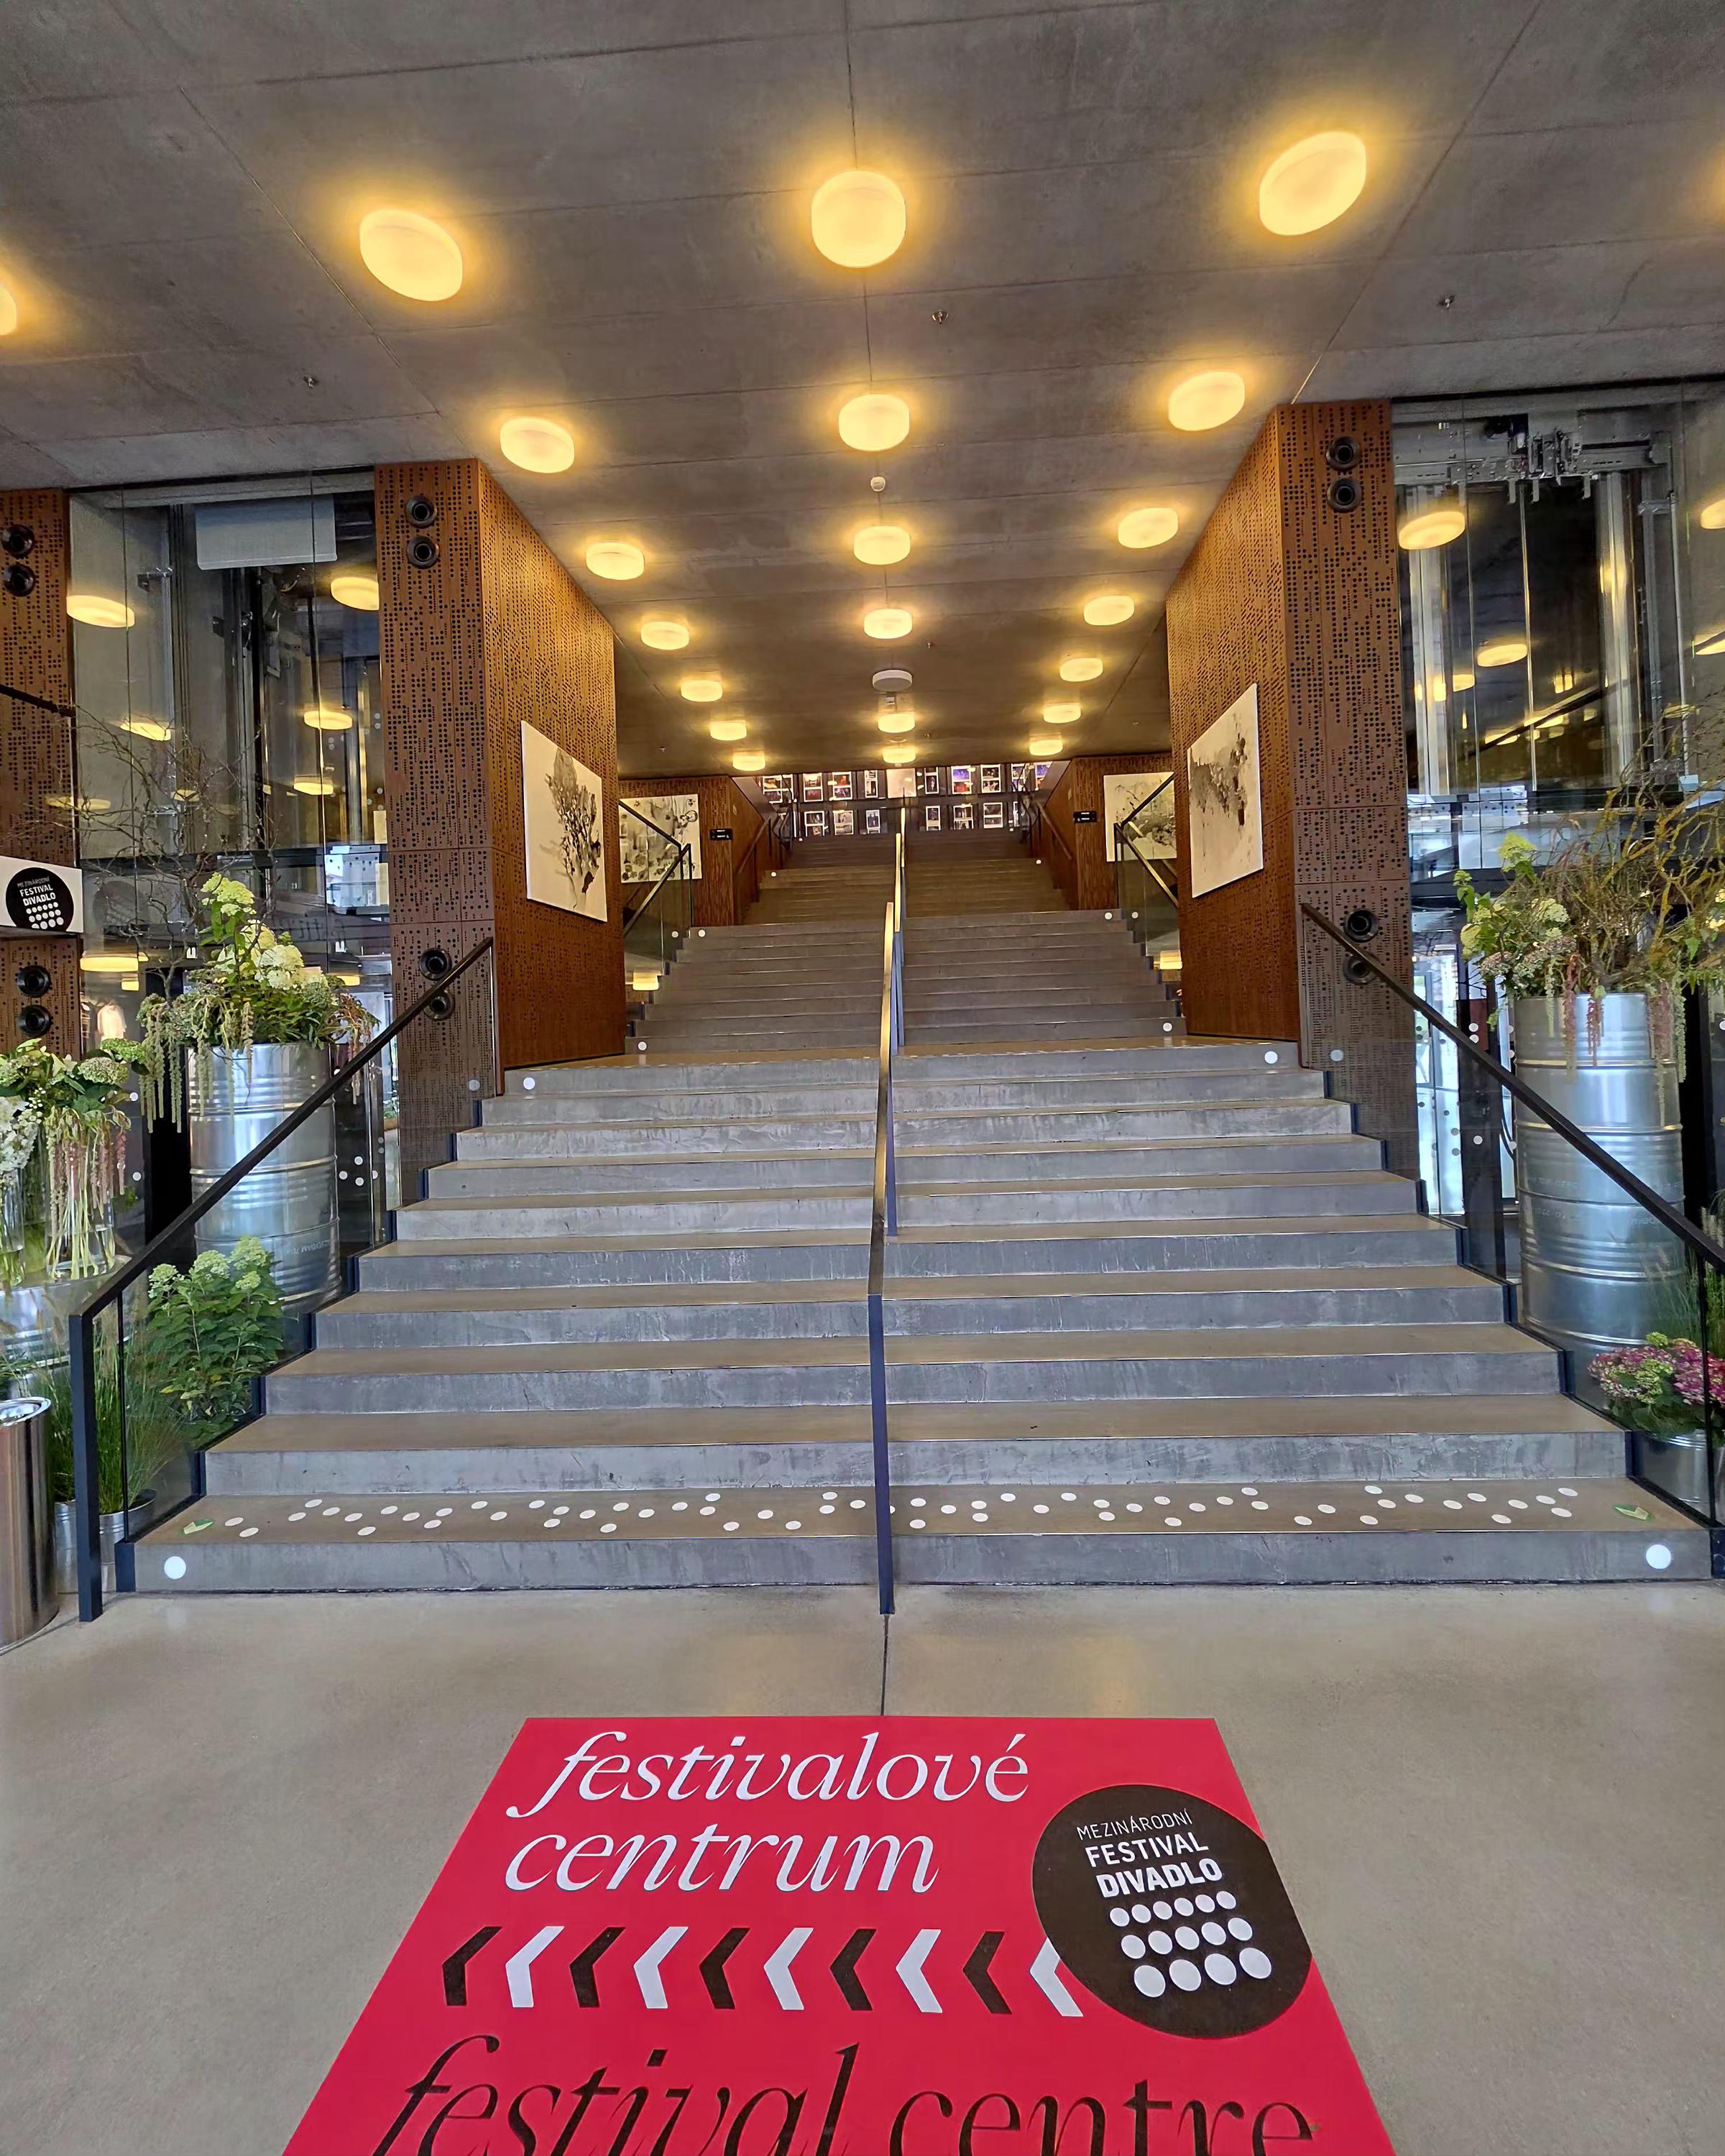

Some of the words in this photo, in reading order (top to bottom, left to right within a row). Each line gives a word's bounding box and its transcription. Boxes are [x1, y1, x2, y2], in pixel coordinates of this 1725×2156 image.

[20, 884, 53, 897] FESTIVAL
[23, 893, 56, 906] DIVADLO
[505, 1731, 1029, 1818] festivalové
[1076, 1808, 1192, 1841] MEZINÁRODNÍ
[505, 1823, 939, 1893] centrum
[1085, 1832, 1209, 1867] FESTIVAL
[1095, 1858, 1223, 1898] DIVADLO
[371, 2035, 860, 2156] festival
[889, 2079, 1313, 2156] centre
